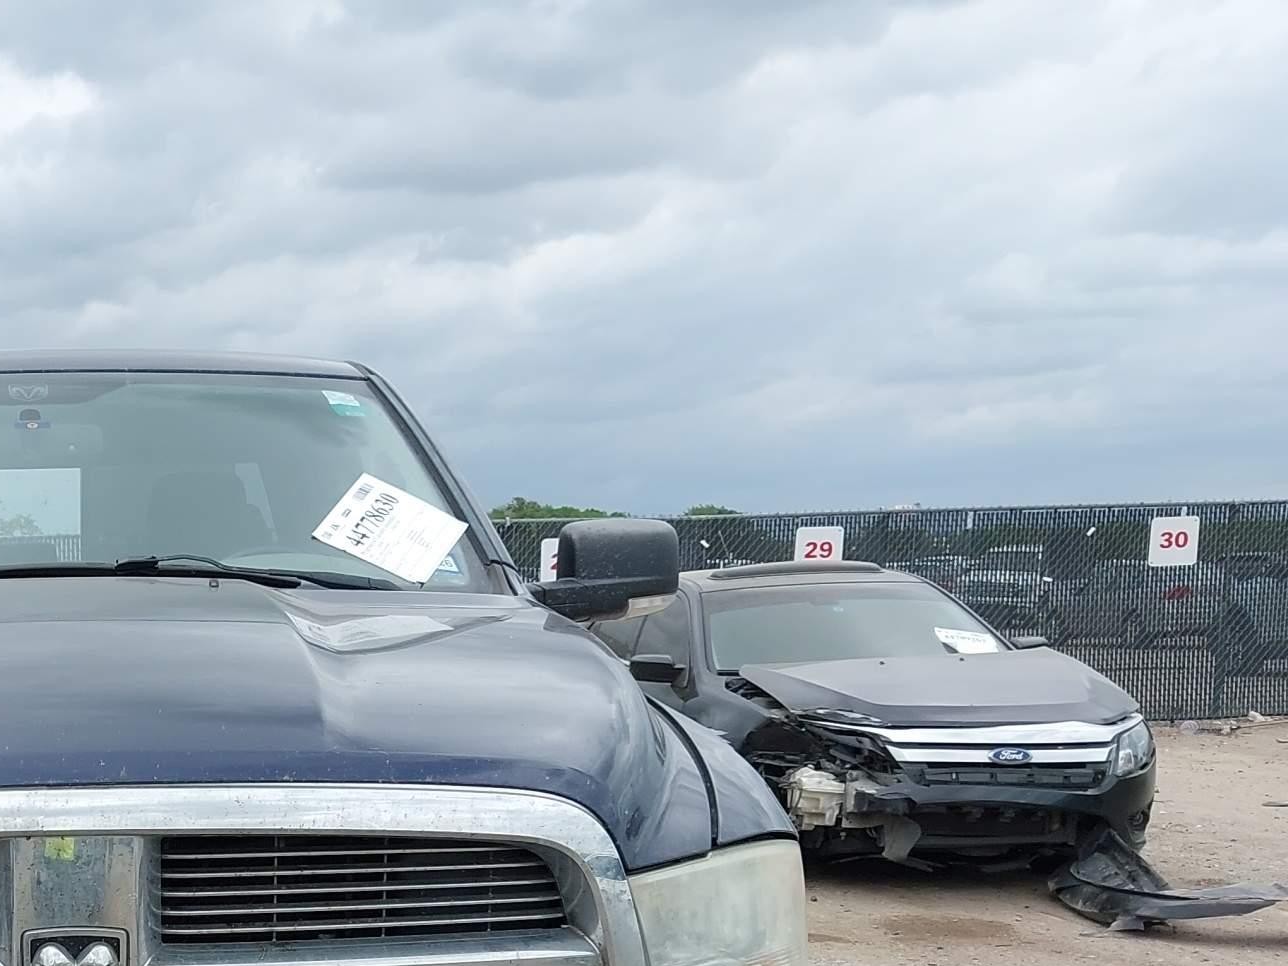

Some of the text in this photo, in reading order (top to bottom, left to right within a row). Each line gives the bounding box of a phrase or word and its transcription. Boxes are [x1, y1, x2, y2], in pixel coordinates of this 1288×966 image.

[346, 492, 400, 547] 44778630
[1159, 531, 1189, 549] 30
[804, 541, 833, 559] 29
[999, 749, 1025, 761] Ford
